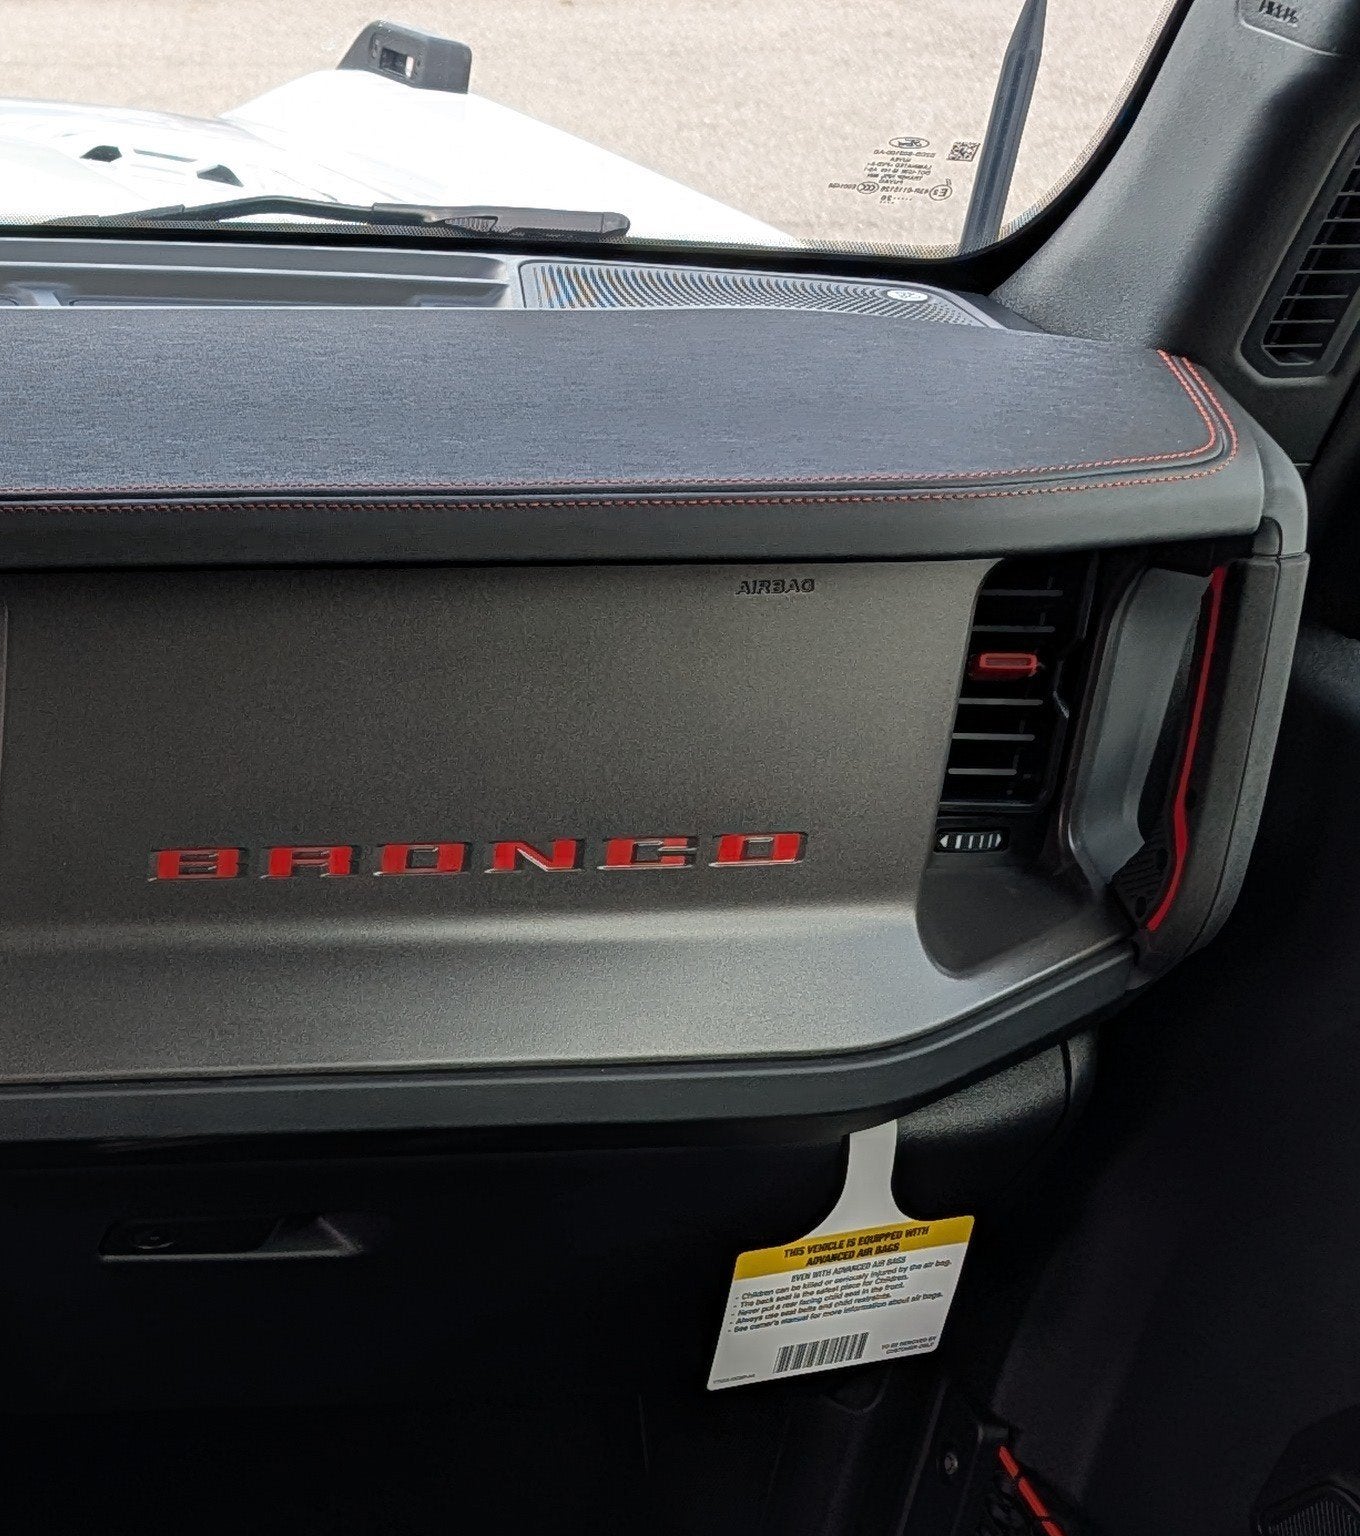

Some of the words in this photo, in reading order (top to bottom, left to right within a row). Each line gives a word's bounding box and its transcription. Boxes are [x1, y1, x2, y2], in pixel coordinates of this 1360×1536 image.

[735, 578, 815, 594] AIRBAG
[149, 832, 808, 882] BRONCO
[846, 1237, 856, 1247] IS
[904, 1225, 930, 1238] WITH
